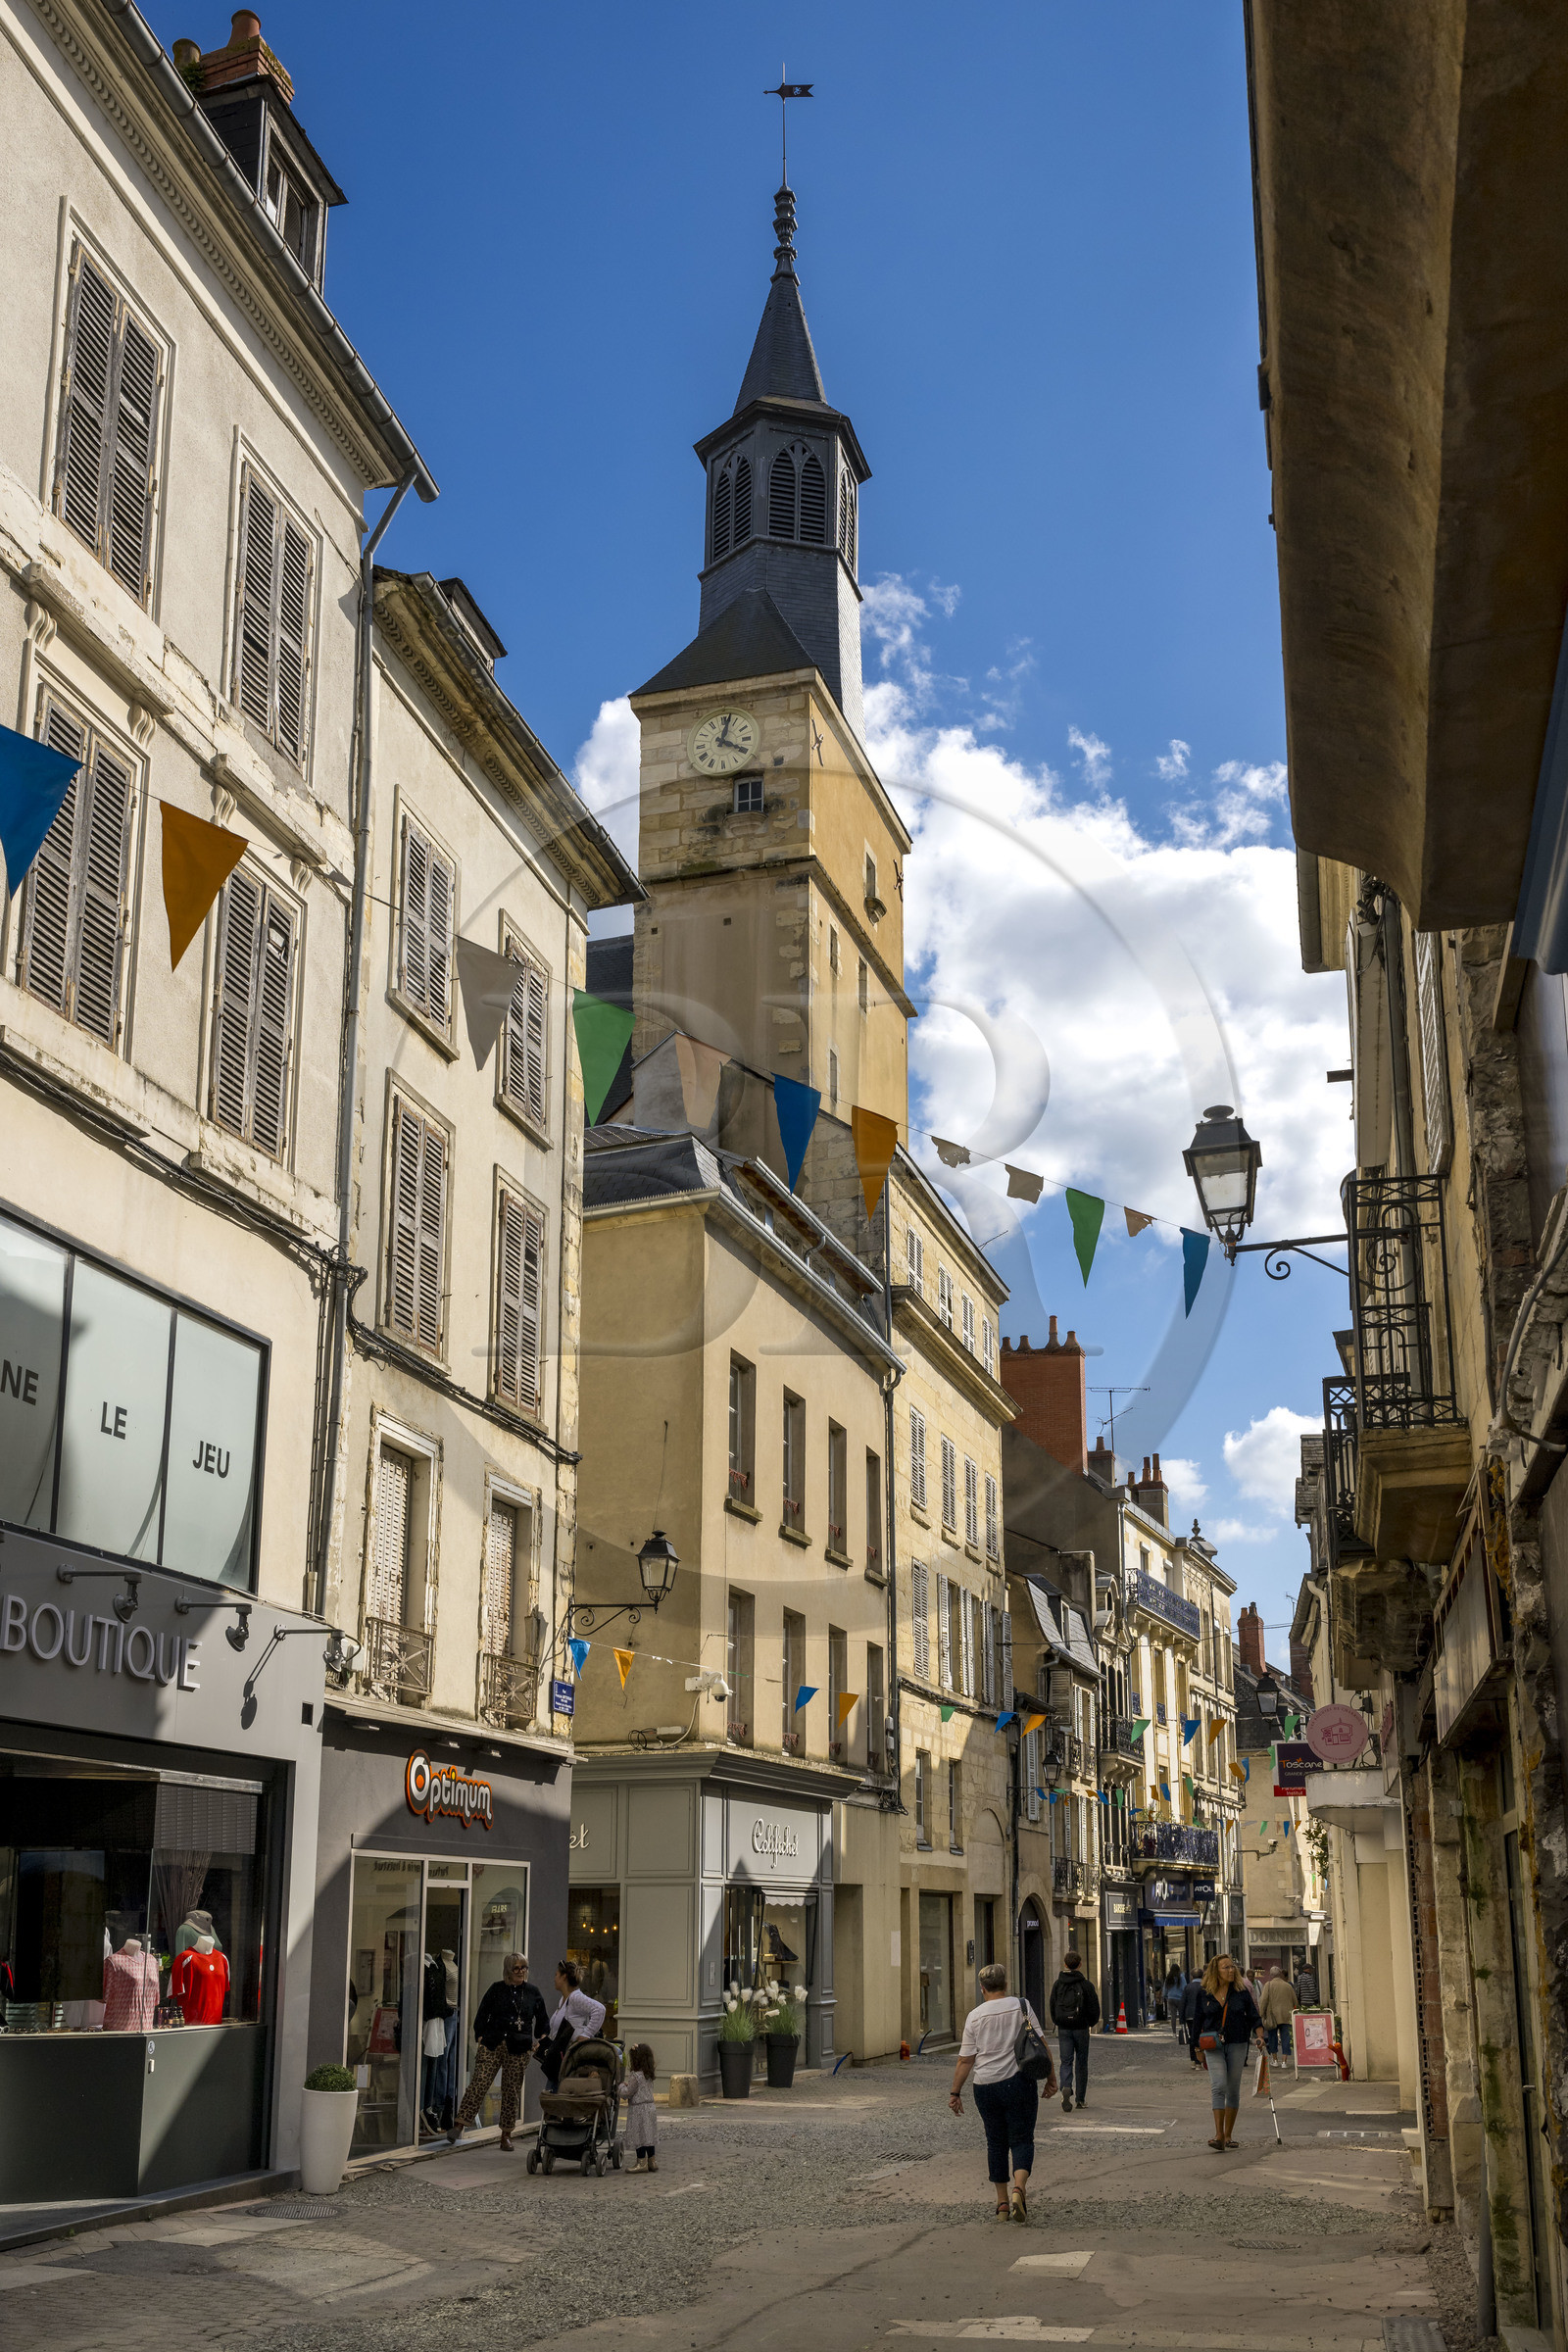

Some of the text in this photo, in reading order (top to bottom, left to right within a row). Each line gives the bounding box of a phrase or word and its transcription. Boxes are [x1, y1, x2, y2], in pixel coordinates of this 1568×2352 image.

[100, 1400, 127, 1440] LE
[192, 1440, 231, 1479] JEU
[0, 1593, 203, 1692] BOUTIQUE
[409, 1753, 493, 1823] Optimum
[1279, 1759, 1323, 1769] Toscane
[752, 1818, 799, 1869] Colifichet
[1195, 1885, 1213, 1893] ATOL
[1250, 1931, 1305, 1943] DORNIER
